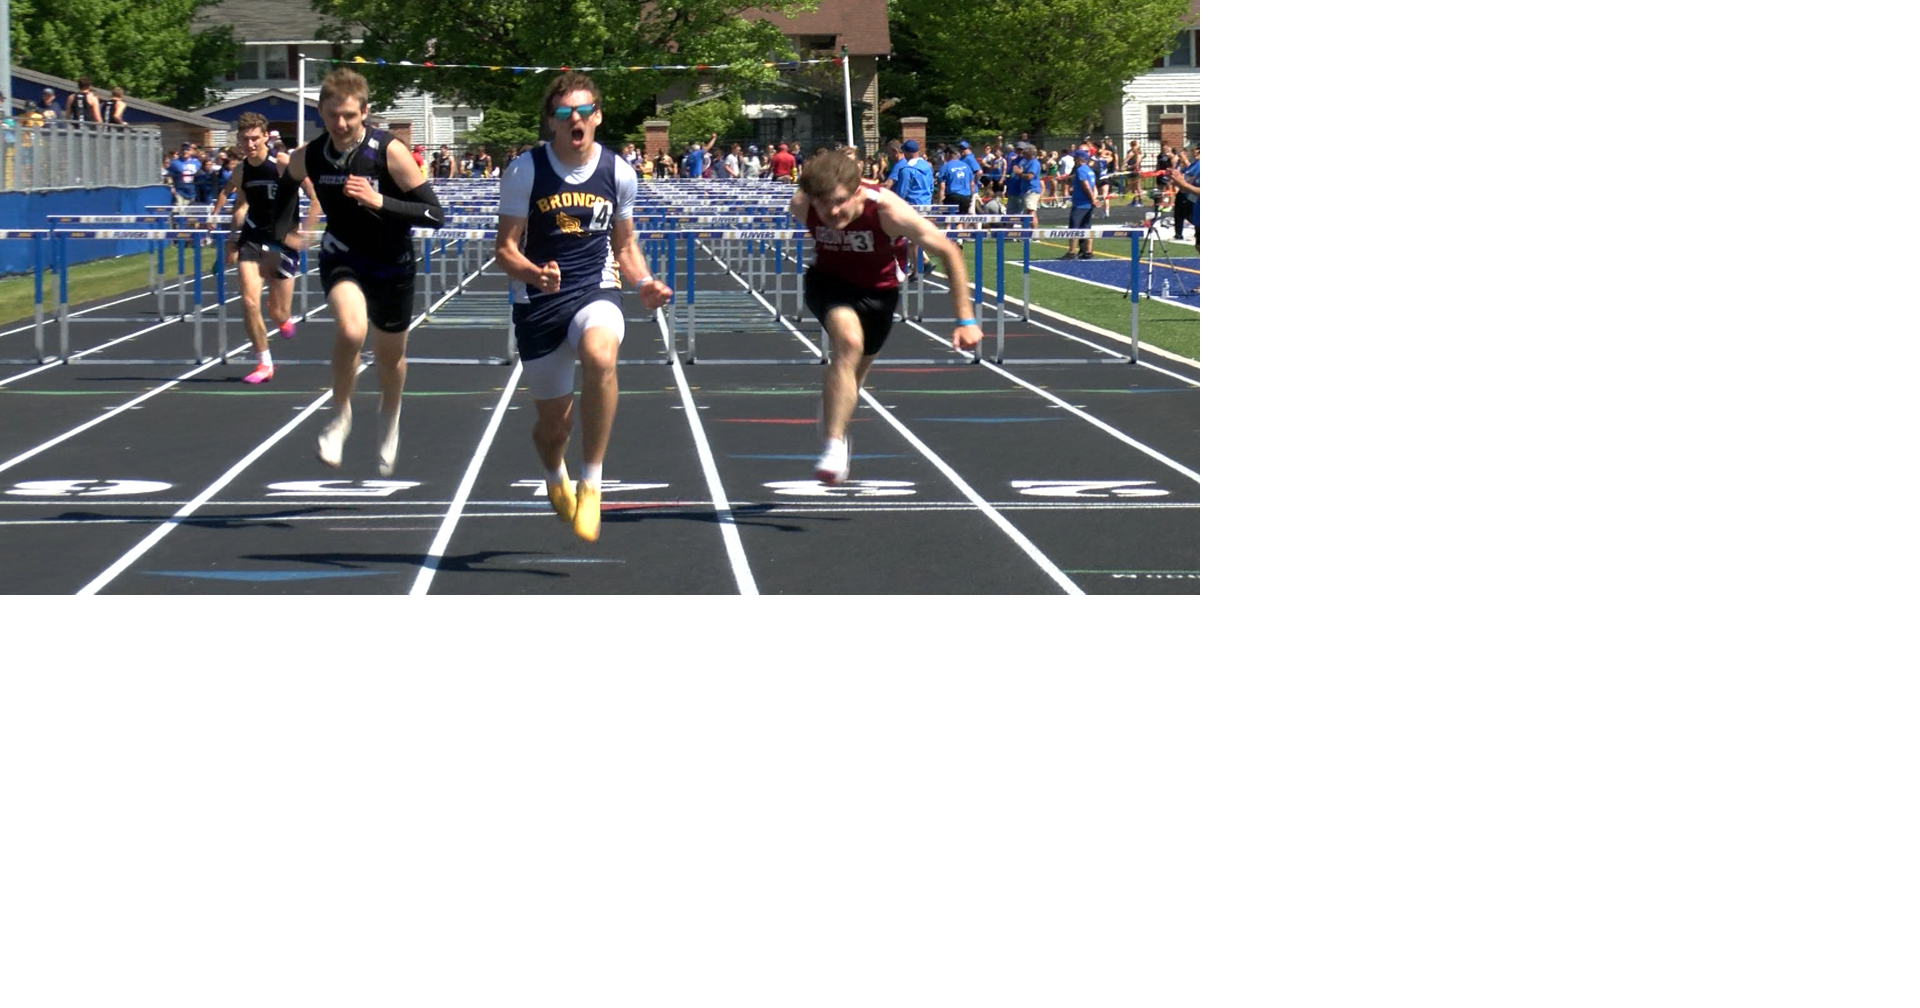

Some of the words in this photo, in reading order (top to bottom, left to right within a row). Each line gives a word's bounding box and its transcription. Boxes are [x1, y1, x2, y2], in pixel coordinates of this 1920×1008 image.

[595, 204, 608, 228] 4
[959, 215, 988, 223] FLIVVERS
[740, 232, 776, 240] FLIVVERS
[854, 234, 868, 250] 3
[1049, 229, 1086, 239] FLIVVERS
[266, 480, 422, 497] 5
[763, 479, 916, 496] 3
[1010, 480, 1171, 496] 2
